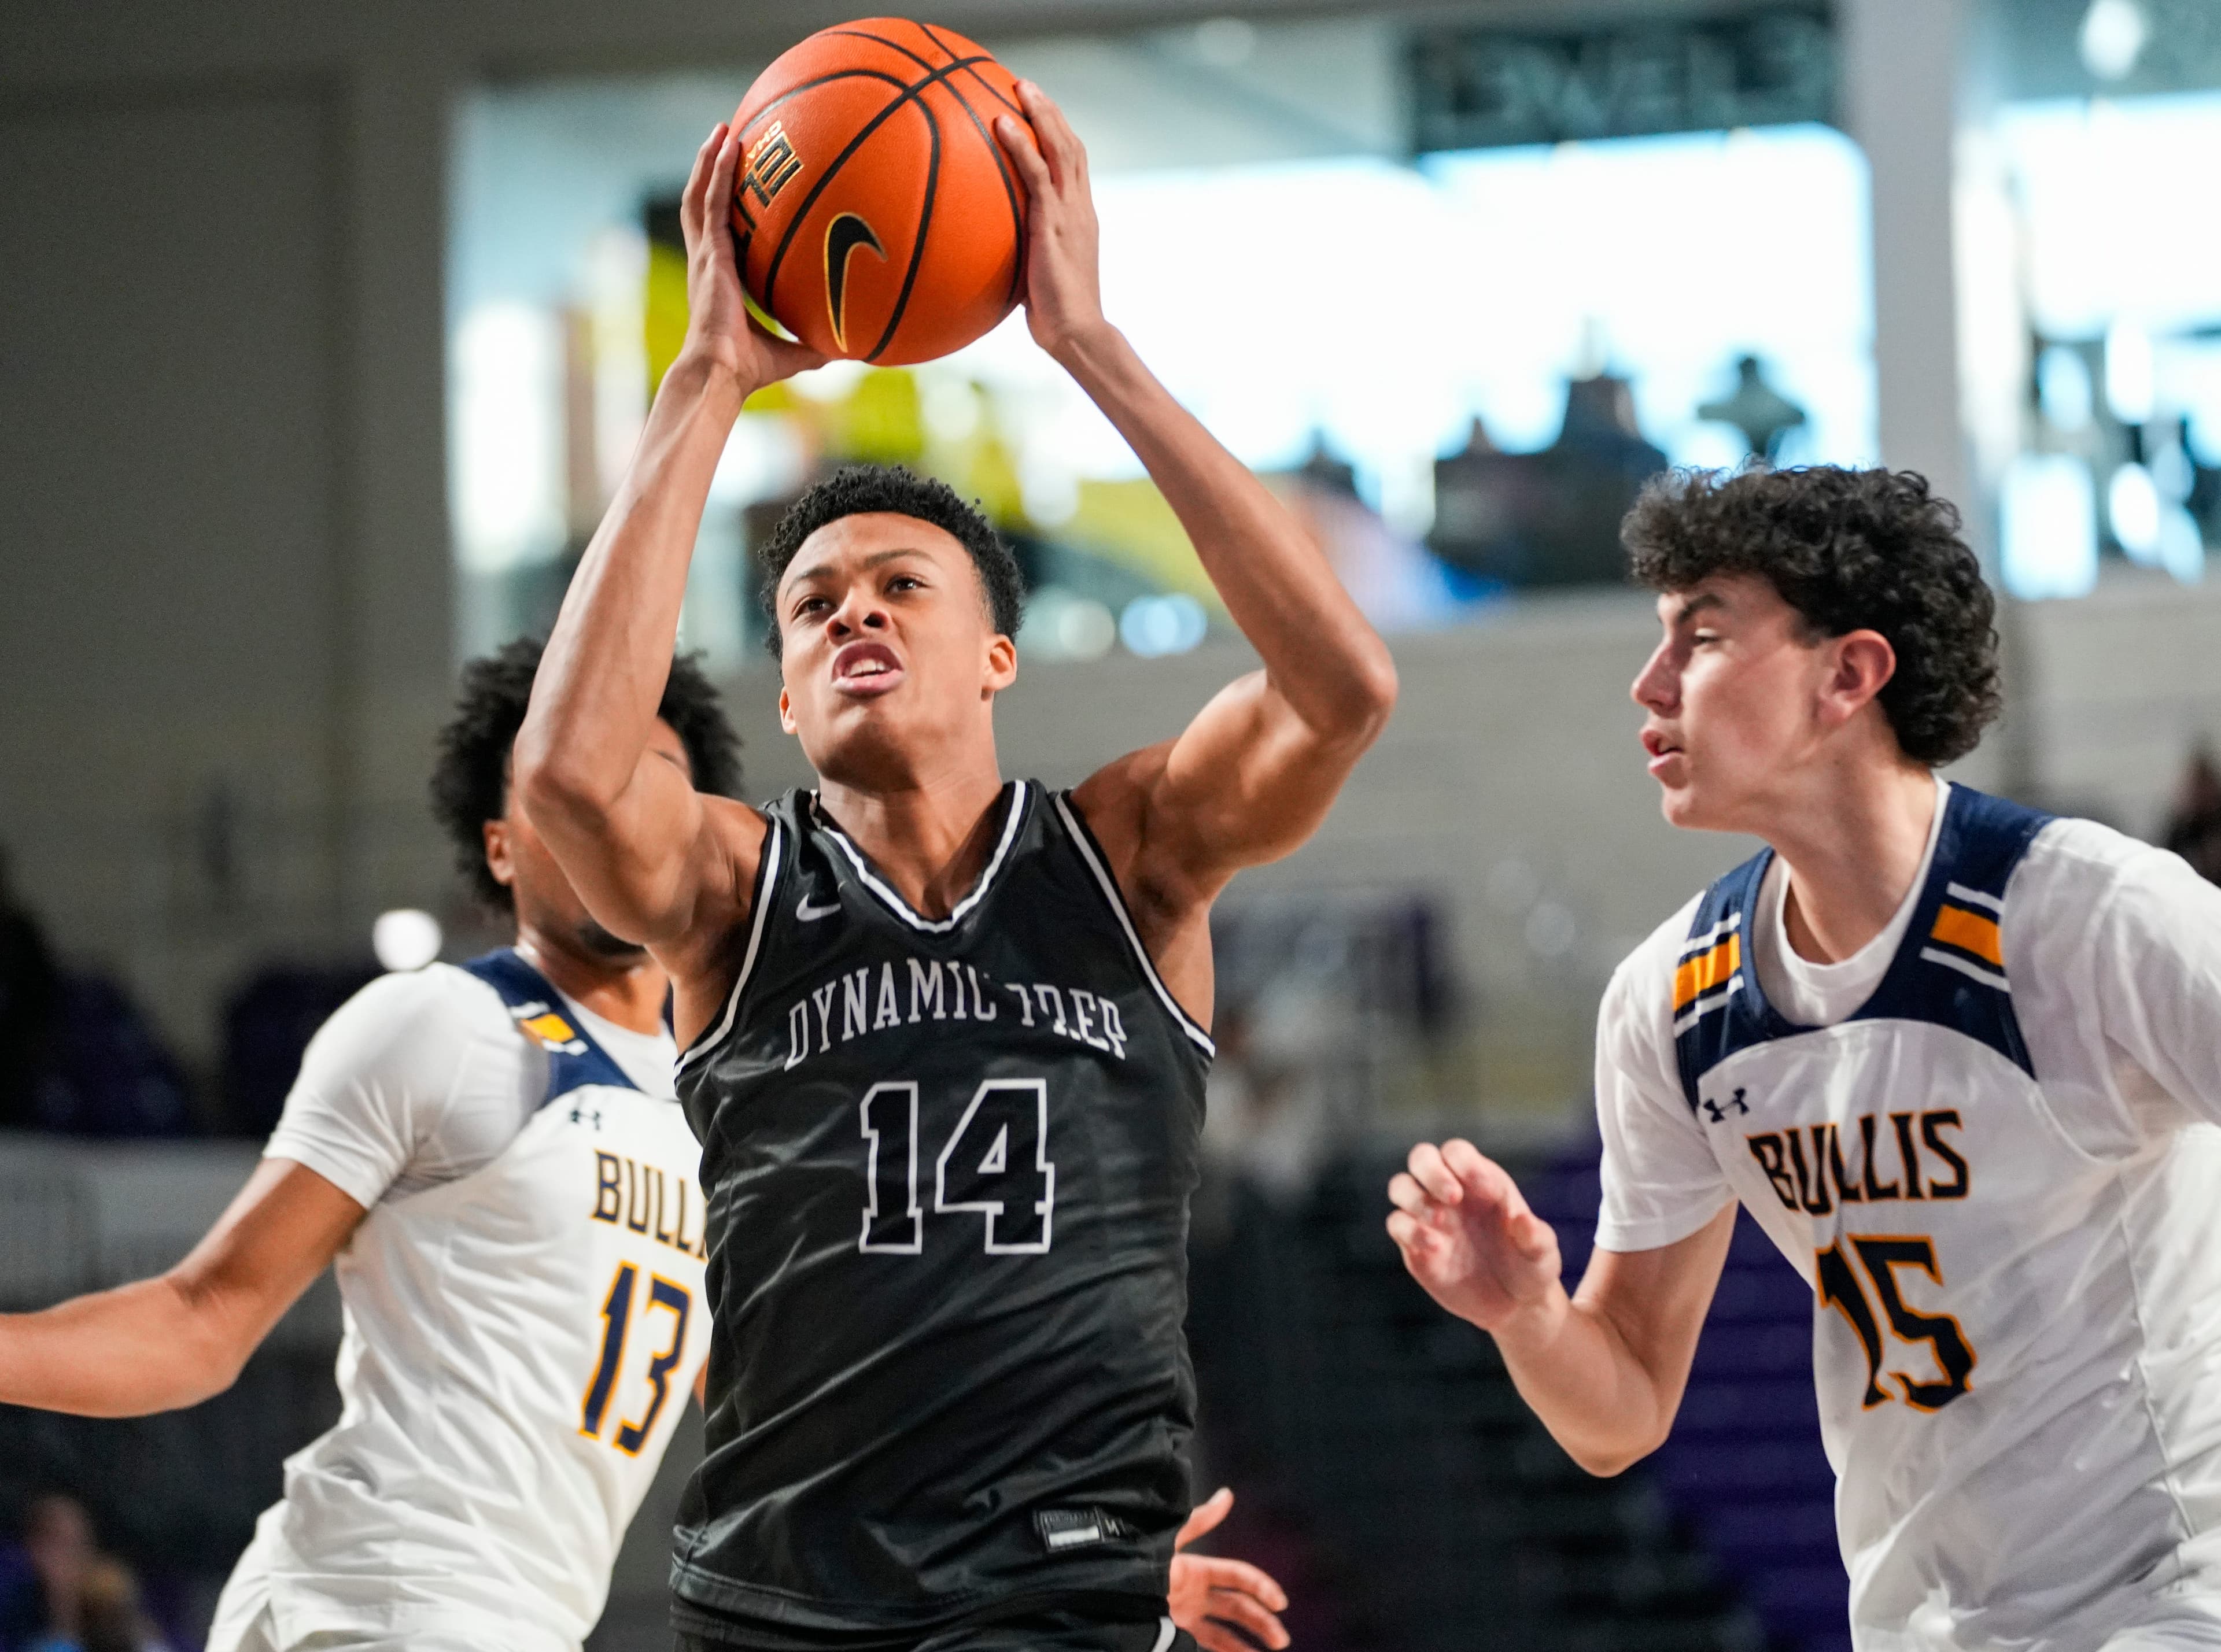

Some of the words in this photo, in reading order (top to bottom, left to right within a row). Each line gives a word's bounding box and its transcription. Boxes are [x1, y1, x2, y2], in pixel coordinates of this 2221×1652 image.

[729, 130, 805, 259] ELIT
[744, 120, 782, 168] CHA
[784, 957, 997, 1072] DYNAMIC
[589, 1148, 710, 1263] BULL
[859, 1078, 1054, 1254] 14
[1744, 1108, 1970, 1216] BULLIS
[577, 1259, 692, 1458] 13
[1814, 1232, 1977, 1414] 15
